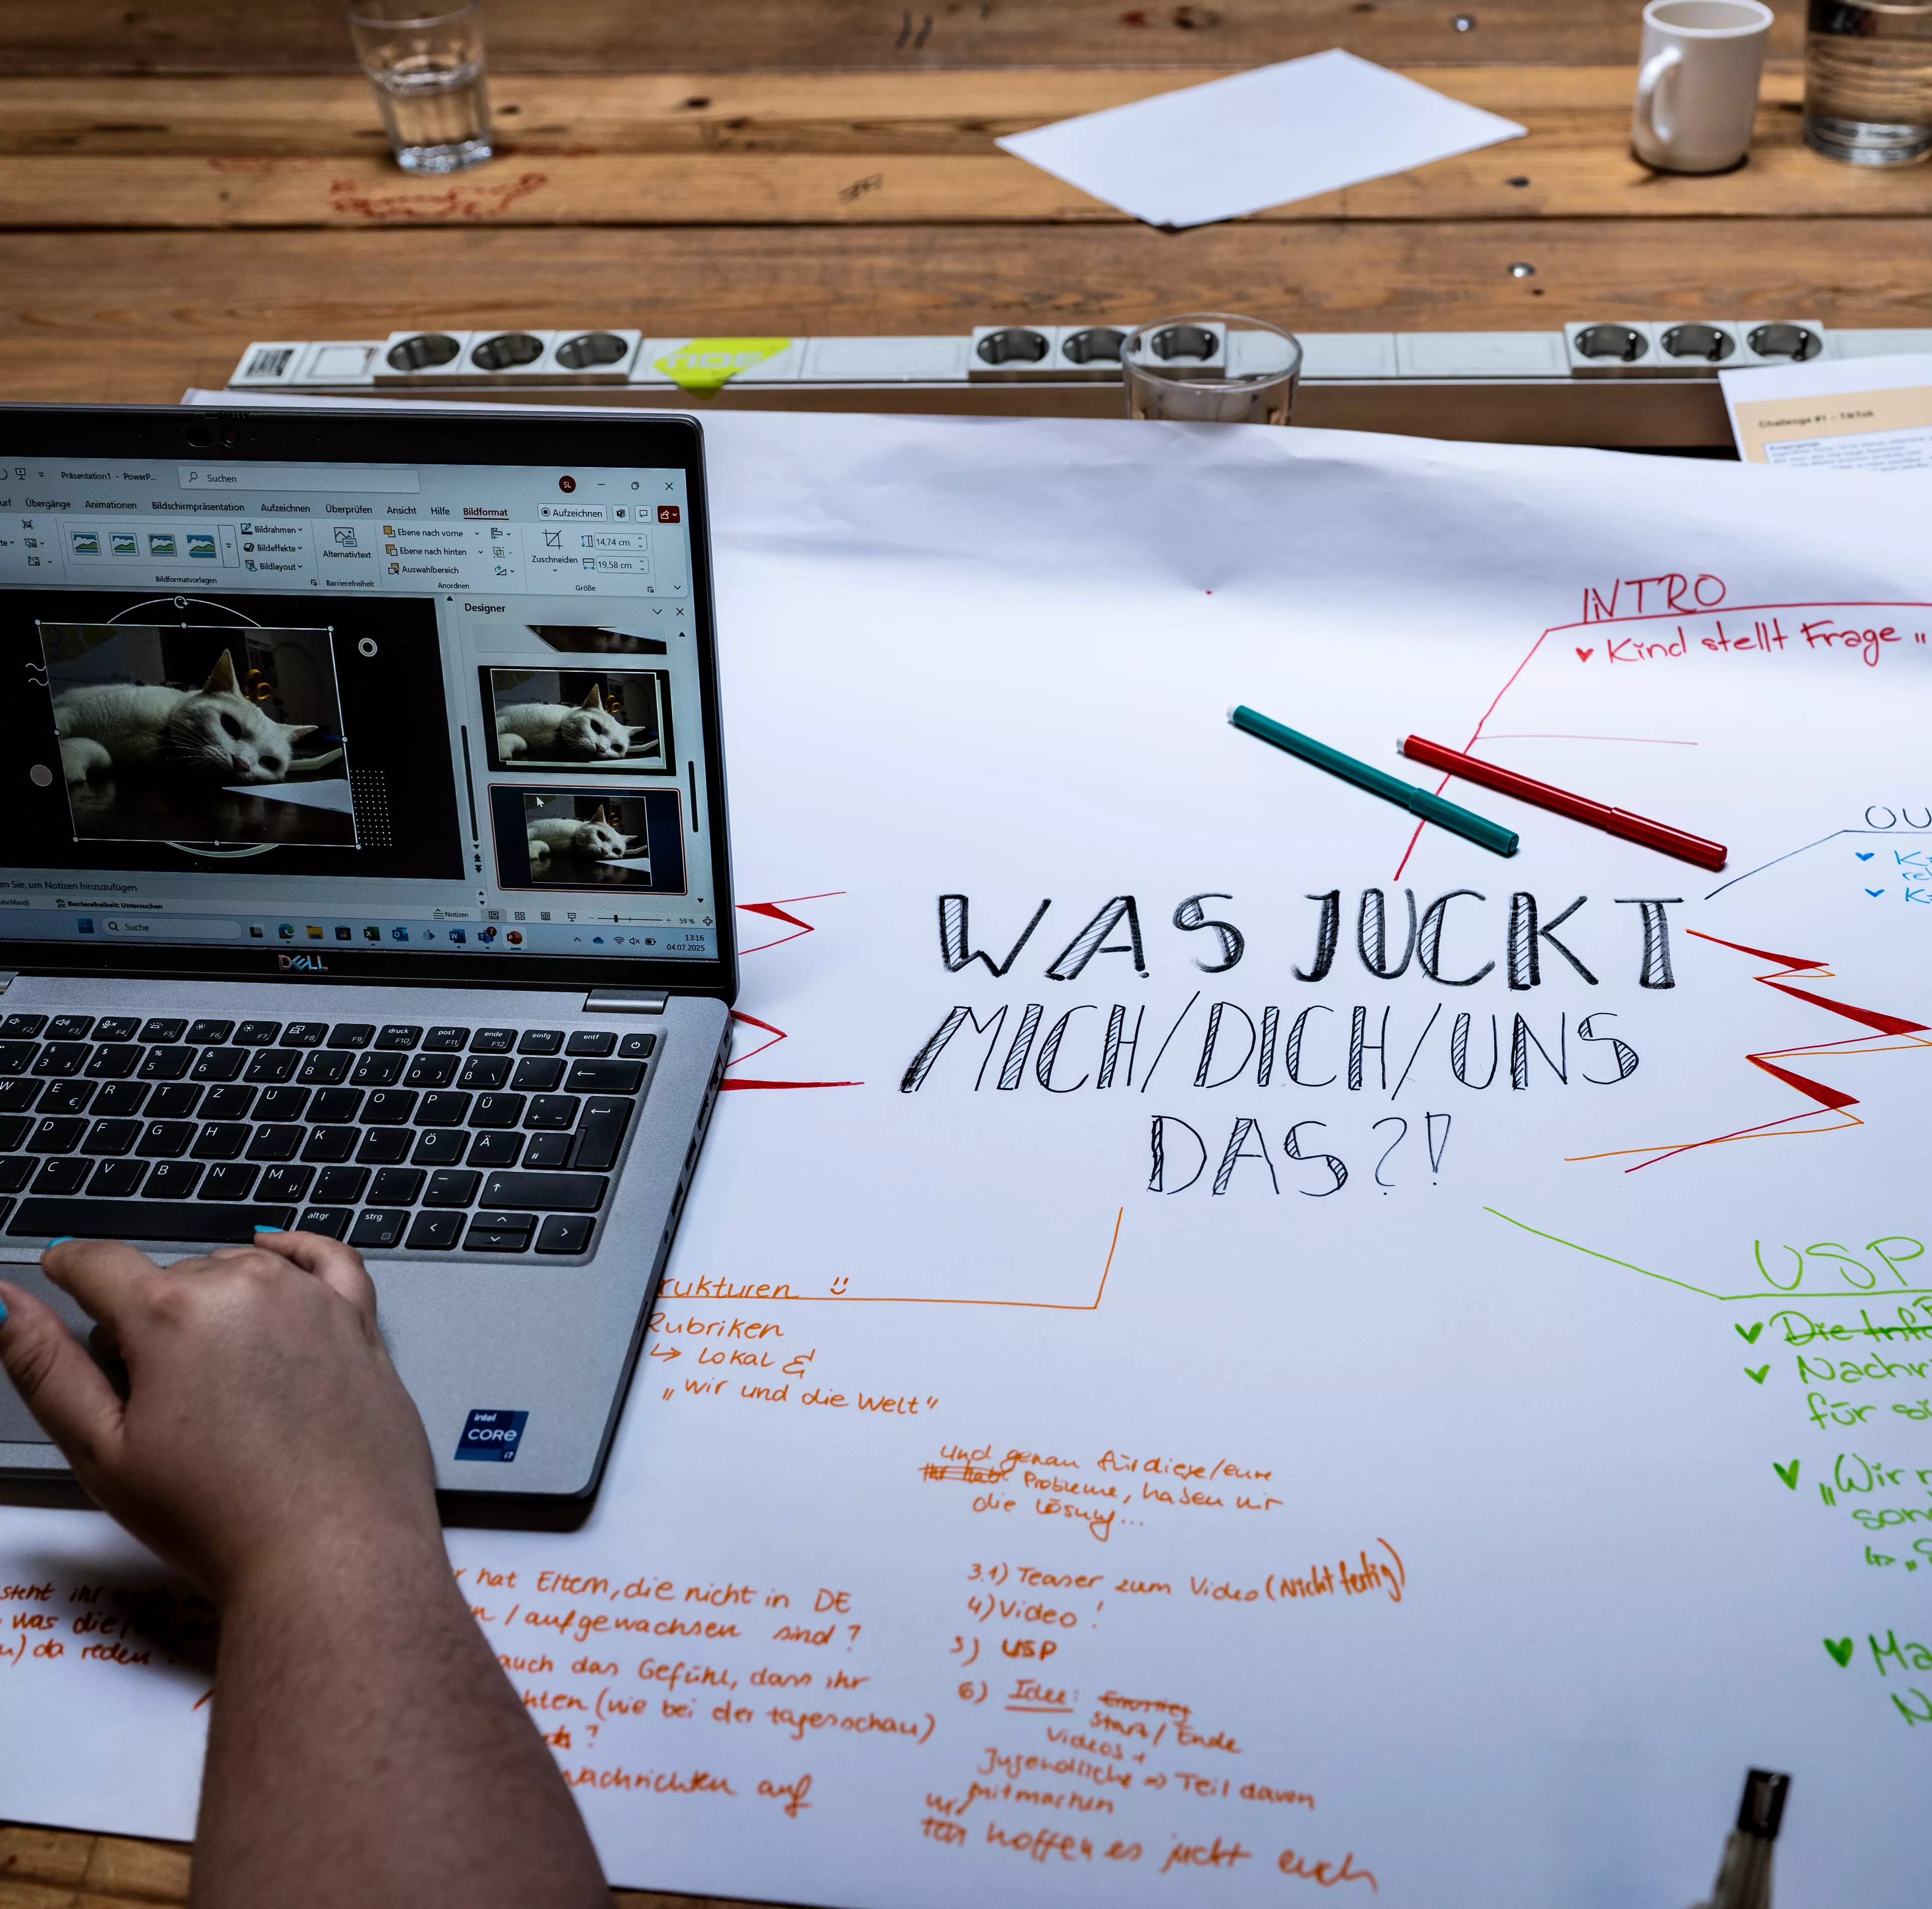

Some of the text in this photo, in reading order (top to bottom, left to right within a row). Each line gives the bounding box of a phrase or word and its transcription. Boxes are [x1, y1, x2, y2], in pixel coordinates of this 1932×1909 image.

[1759, 416, 1812, 428] Challenge
[60, 471, 157, 481] Präsentation1 PowerP...
[206, 474, 237, 483] Suchen
[563, 480, 572, 489] SL
[25, 497, 71, 511] Übergänge
[85, 500, 137, 509] Animationen
[151, 501, 245, 513] Bildschirmpräsentation
[261, 503, 311, 513] Aufzeichnen
[325, 504, 373, 516] Überprüfen
[386, 506, 417, 515] Ansicht
[431, 506, 450, 515] Hilfe
[462, 507, 508, 516] Bildformat
[552, 509, 603, 518] Aufzeichnen
[254, 525, 296, 534] Bildrahmen
[397, 528, 421, 536] Ebene
[422, 529, 440, 537] nach
[257, 543, 296, 552] Bildeffekte
[596, 538, 617, 546] 14,74
[323, 550, 372, 558] Alternativtext
[399, 547, 423, 555] Ebene
[443, 548, 467, 556] hinten
[531, 555, 578, 564] Zuschneiden
[598, 560, 619, 569] 19,58
[259, 562, 296, 572] Bildlayout
[401, 565, 459, 574] Auswahlbereich
[155, 575, 217, 586] Bildformatvorlagen
[1583, 573, 1726, 624] INTRO
[464, 603, 506, 615] Designer
[1606, 617, 1902, 667] Kind stellt Frage
[12, 880, 26, 890] Sie,
[45, 881, 78, 890] Notizen
[80, 882, 137, 892] hinzuzufügen
[124, 923, 149, 932] Suche
[685, 934, 704, 942] 13:16
[938, 888, 1684, 992] WAS JUCKT
[666, 944, 705, 952] 04.07.2025
[278, 954, 328, 970] DELL
[51, 1083, 63, 1093] E
[105, 1085, 116, 1094] R
[481, 1096, 493, 1108] Ü
[425, 1133, 436, 1145] Ö
[479, 1135, 491, 1147] Ä
[307, 1212, 330, 1221] altgr
[365, 1213, 383, 1222] strg
[1754, 1236, 1927, 1292] USP
[647, 1311, 783, 1340] Rubriken
[741, 1384, 789, 1401] und
[801, 1388, 848, 1407] die
[1807, 1391, 1878, 1430] für
[474, 1414, 497, 1422] intel
[1004, 1447, 1081, 1471] genau
[1024, 1469, 1131, 1506] Probleme,
[1143, 1482, 1224, 1507] haben
[1236, 1497, 1282, 1511] wir
[973, 1493, 1016, 1512] die
[1018, 1567, 1103, 1588] Teaser
[1115, 1579, 1171, 1594] zum
[1190, 1576, 1258, 1602] Video
[476, 1568, 517, 1588] hat
[537, 1571, 619, 1601] Eltern,
[624, 1578, 674, 1601] die
[685, 1584, 755, 1606] nicht
[765, 1590, 789, 1610] in
[814, 1589, 850, 1614] DE
[525, 1610, 740, 1642] aufgewachsen
[773, 1625, 835, 1645] sind
[1002, 1639, 1057, 1661] USP
[497, 1653, 865, 1691] auch das Gefühl, dass ihr
[958, 1682, 988, 1704] 6)
[661, 1696, 695, 1718] bei
[712, 1701, 753, 1723] der
[1175, 1719, 1243, 1756] Ende
[977, 1745, 1316, 1811] Jugendliche Teil davon
[756, 1773, 813, 1818] auf
[985, 1820, 1094, 1864] hoffen
[1103, 1839, 1144, 1863] es
[1160, 1833, 1252, 1874] juckt
[1276, 1847, 1380, 1894] euch
